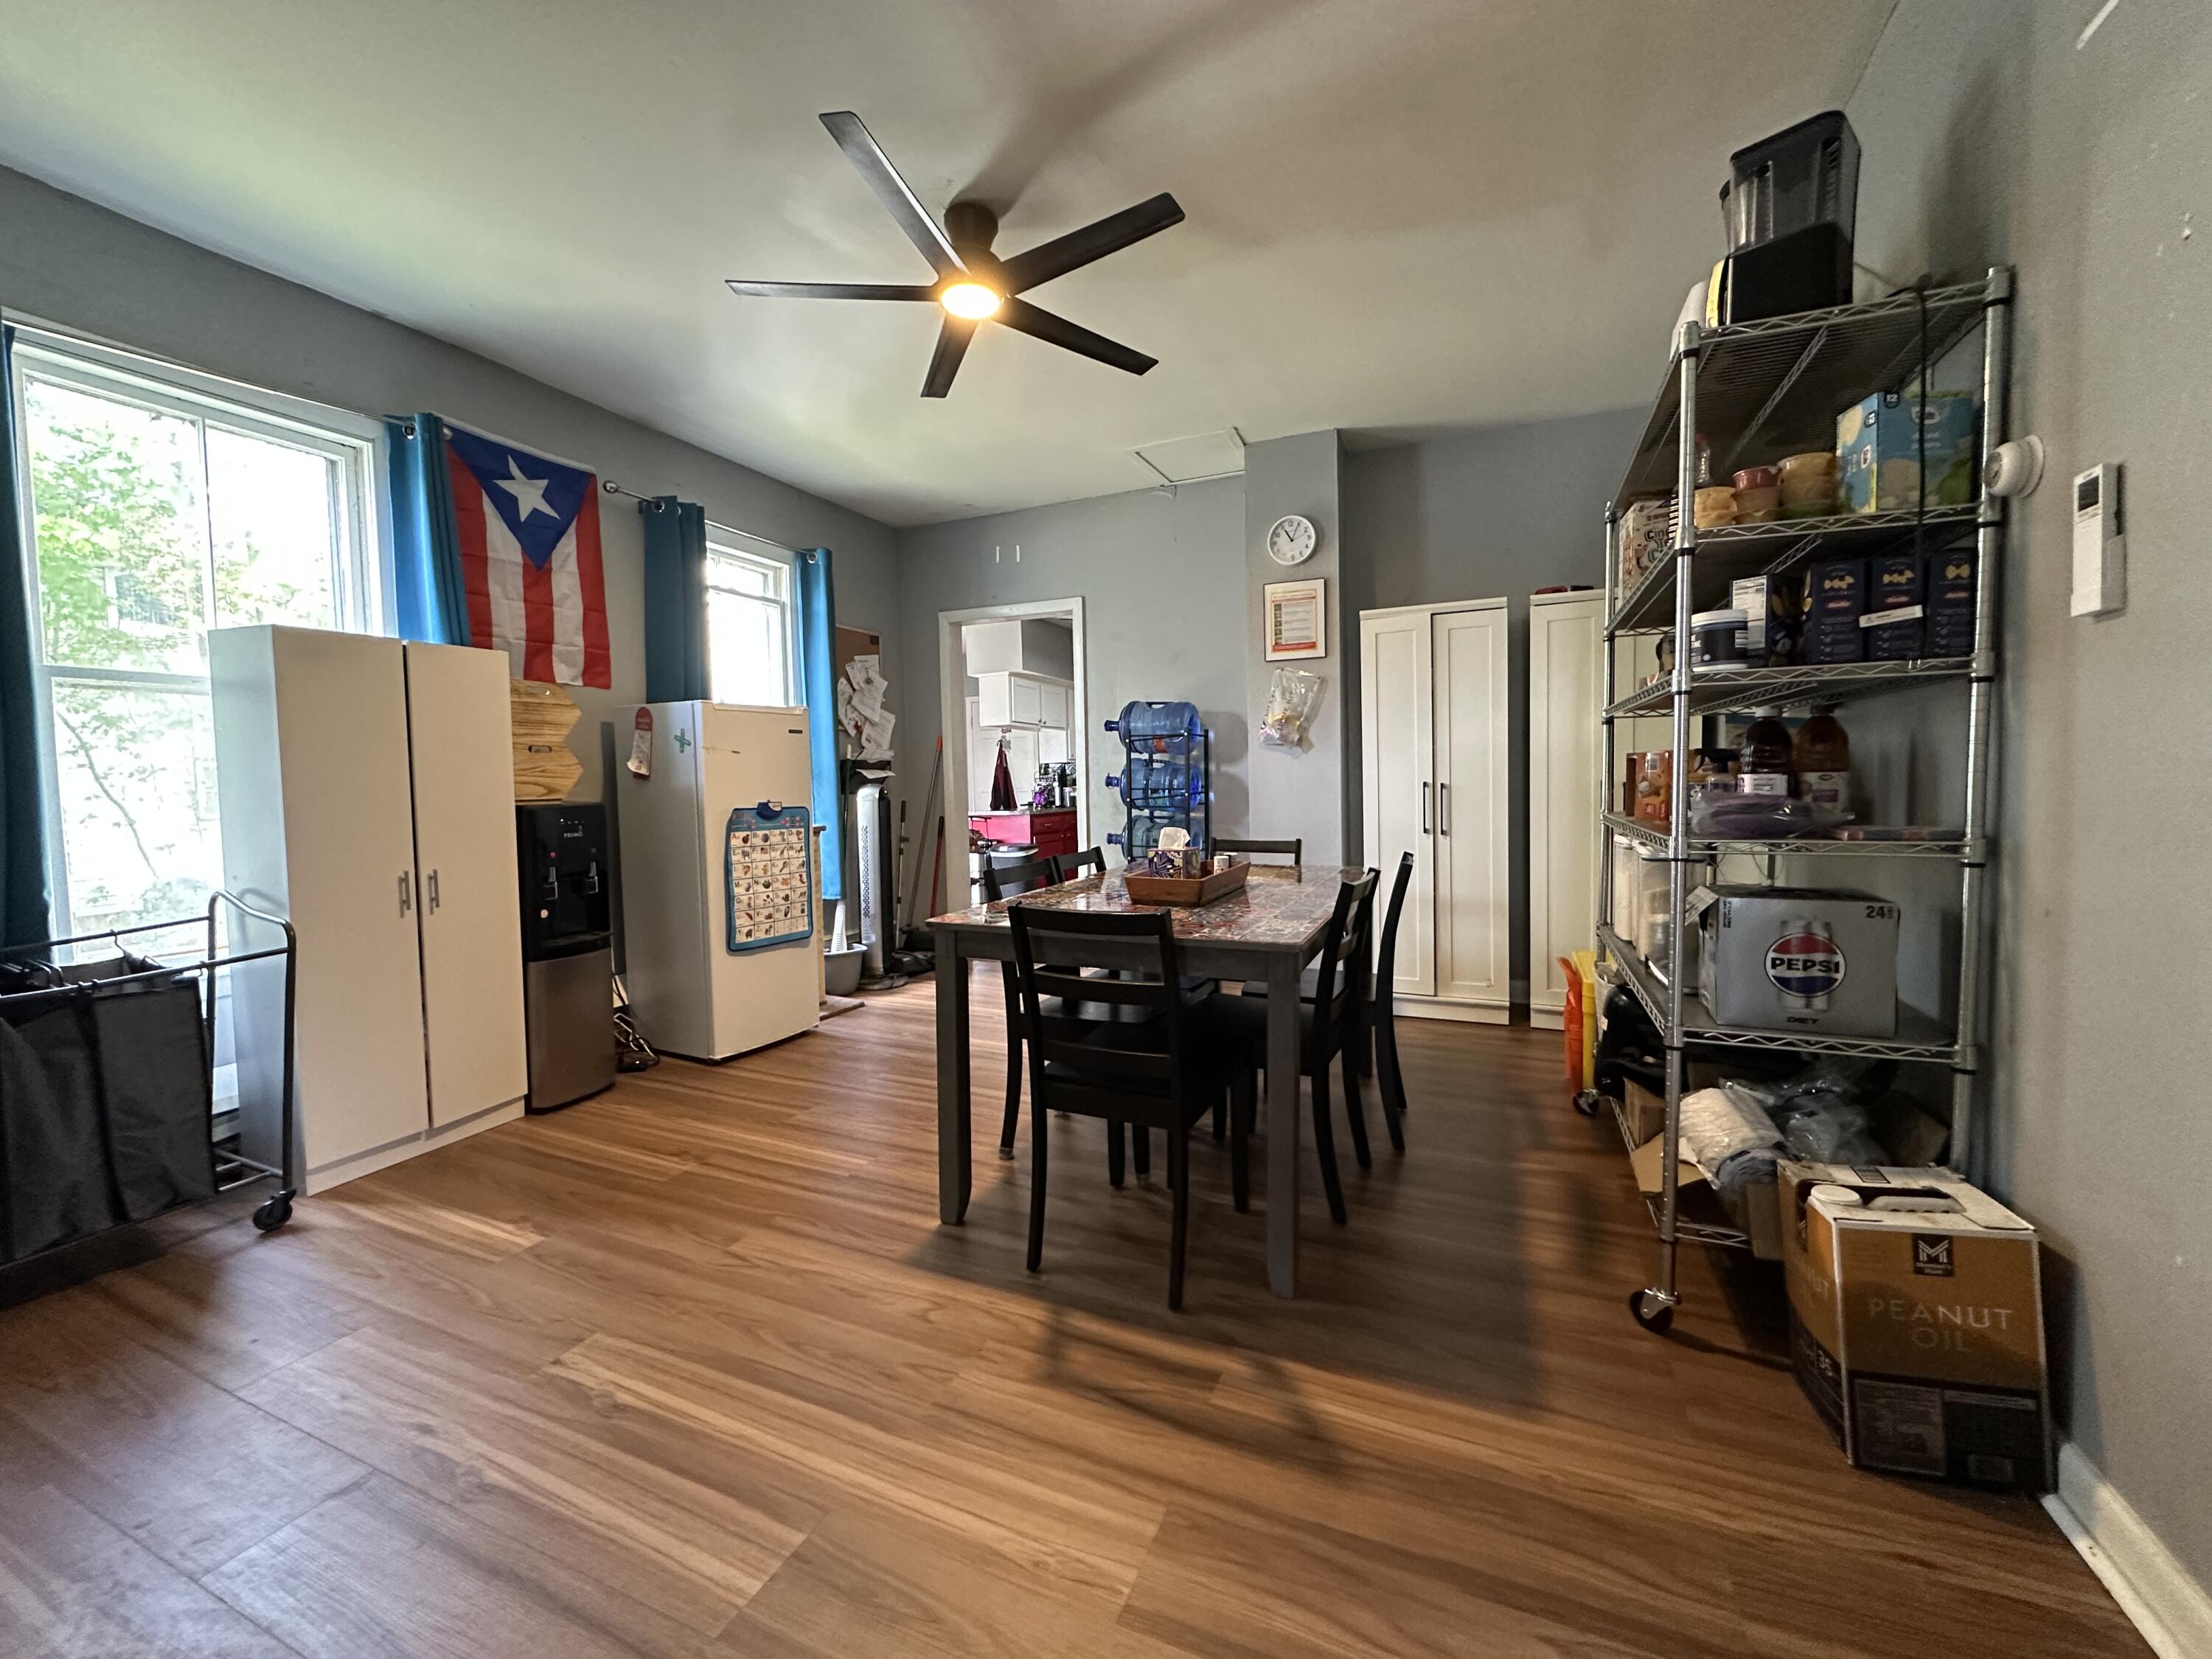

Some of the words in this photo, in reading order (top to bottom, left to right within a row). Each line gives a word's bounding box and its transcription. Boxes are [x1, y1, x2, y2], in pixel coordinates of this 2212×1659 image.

[1885, 393, 1899, 403] 12
[1865, 905, 1886, 919] 24
[1770, 956, 1840, 974] PEPSI
[1787, 1015, 1820, 1025] DIET
[1866, 1297, 2014, 1330] PEANUT
[1912, 1327, 1973, 1353] OIL
